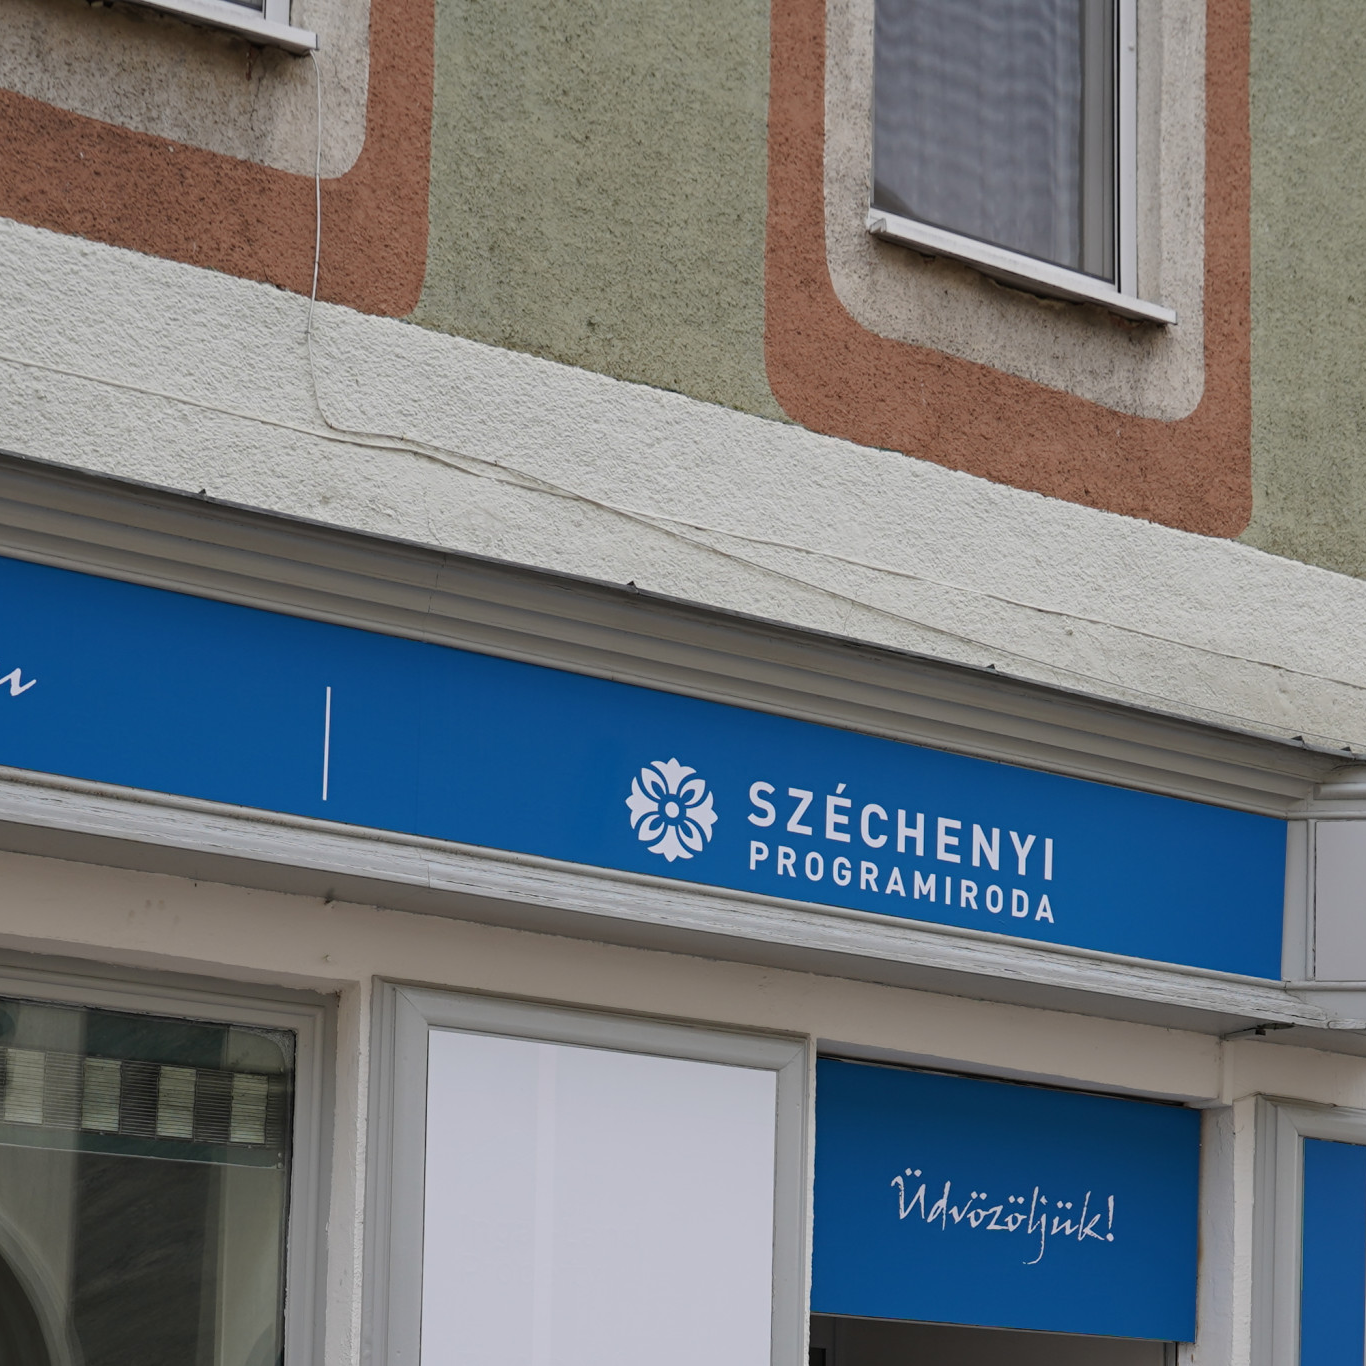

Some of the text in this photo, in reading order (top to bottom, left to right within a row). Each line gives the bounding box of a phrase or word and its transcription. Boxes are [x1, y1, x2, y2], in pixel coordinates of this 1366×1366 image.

[747, 781, 1054, 882] SZÉCHENYI
[749, 840, 1055, 924] PROGRAMIRODA
[891, 1168, 1114, 1264] Üdvözöljük!
